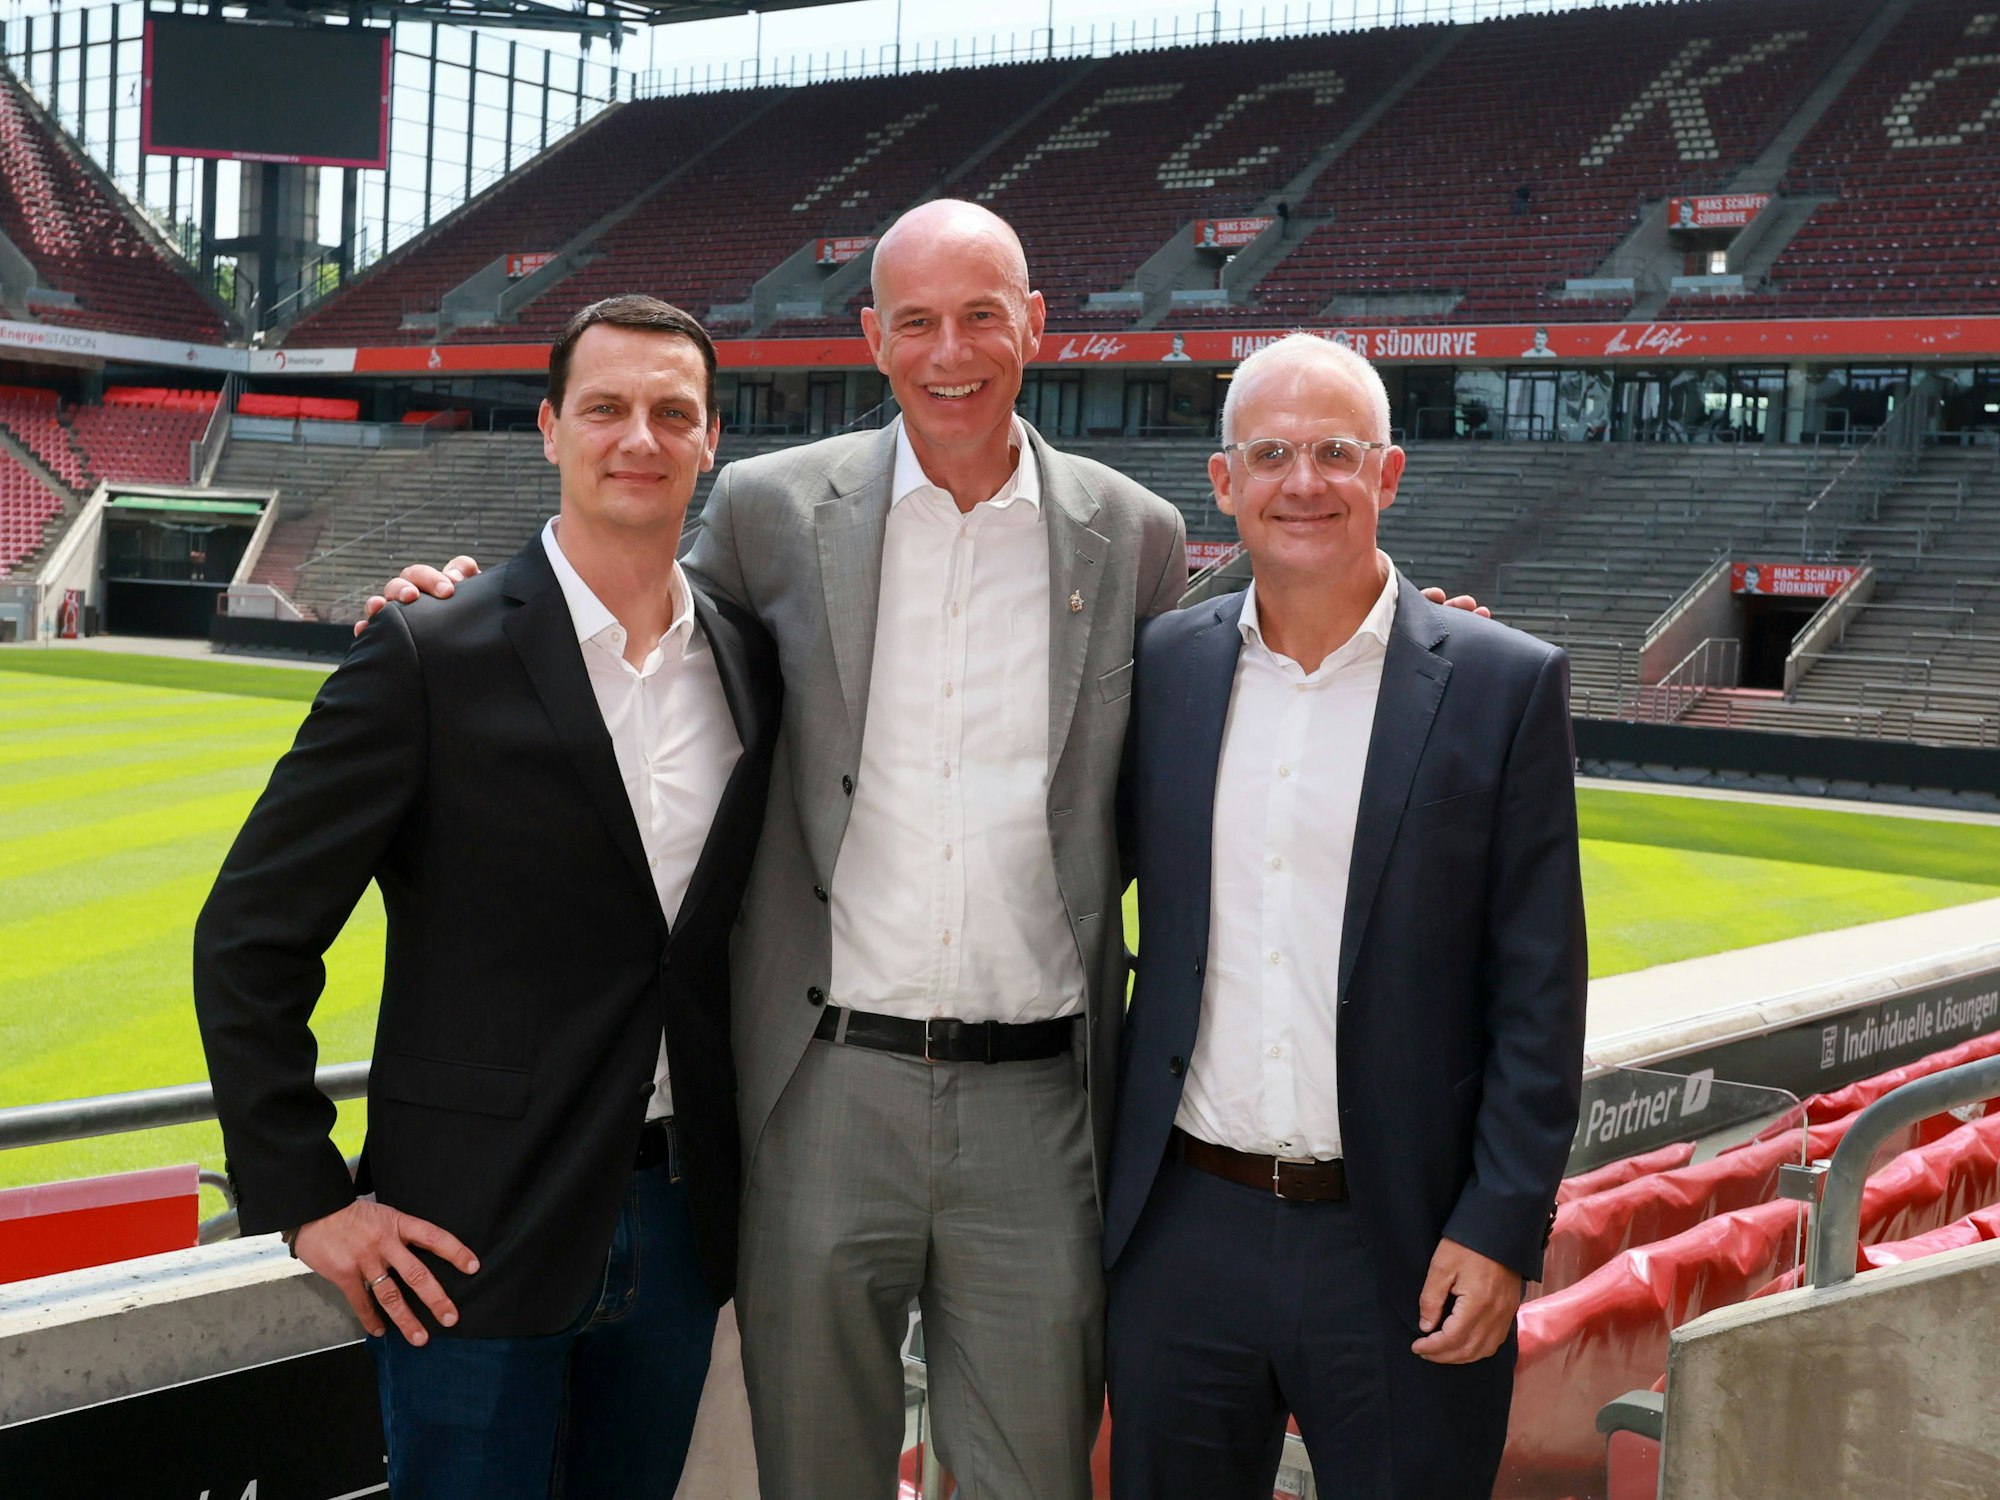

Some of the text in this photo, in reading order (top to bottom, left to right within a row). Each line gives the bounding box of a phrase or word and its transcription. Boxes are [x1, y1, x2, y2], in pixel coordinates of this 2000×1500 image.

[975, 69, 1346, 203] FC
[1698, 199, 1723, 210] HANS
[1375, 329, 1477, 356] SÜDKURVE
[1773, 567, 1801, 580] HANS
[1773, 579, 1828, 594] SÜDKURVE
[1843, 991, 1998, 1063] Individuelle Lösungen
[1584, 1086, 1678, 1147] Partner
